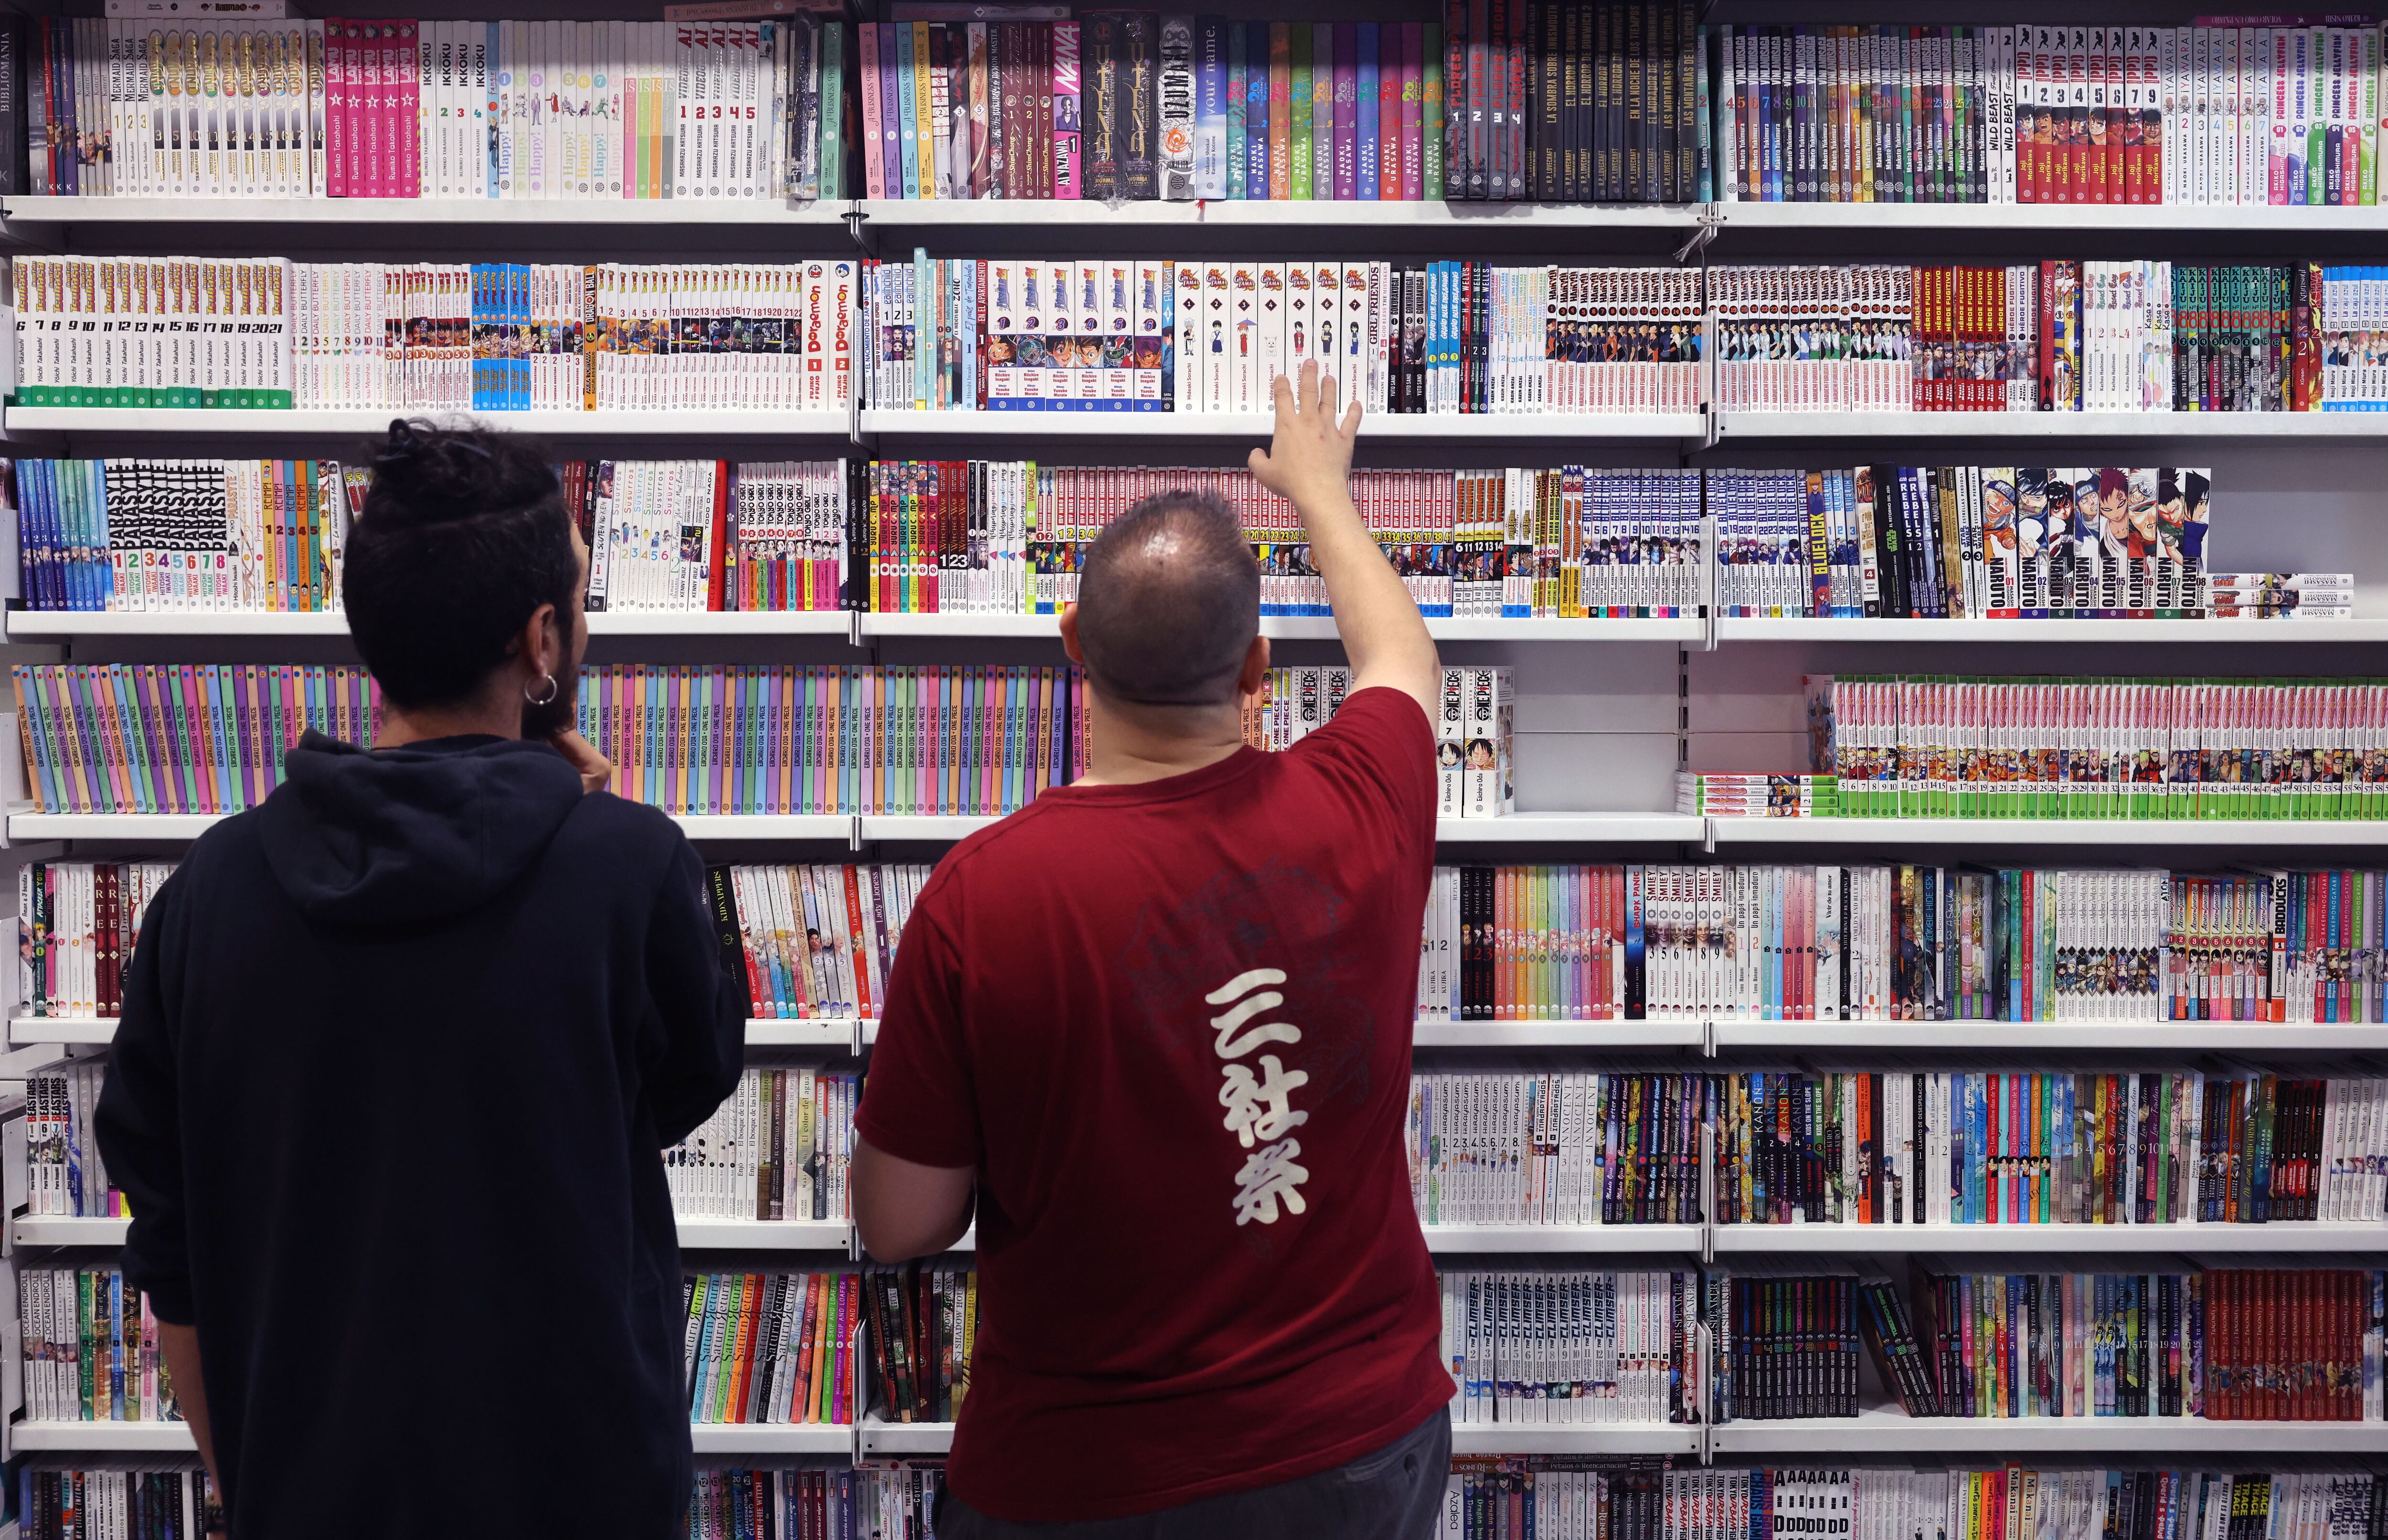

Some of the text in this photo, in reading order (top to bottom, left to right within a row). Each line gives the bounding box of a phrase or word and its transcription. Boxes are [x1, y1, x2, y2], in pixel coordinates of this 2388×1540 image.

[1, 32, 10, 112] BIBLIOMANIA
[111, 38, 121, 102] MERMAID SAGA
[328, 47, 339, 84] LAMU
[1055, 24, 1079, 94] NANA
[1205, 26, 1216, 115] your name.
[746, 107, 755, 119] 5
[1989, 92, 1998, 150] WILD BEAST
[2333, 80, 2341, 118] PRINCESS
[499, 130, 510, 175] Happy!
[1055, 139, 1070, 186] AI YAZAWA
[1071, 138, 1076, 152] 1
[16, 321, 26, 331] 6
[807, 284, 821, 352] Doraemon
[122, 465, 139, 550] PARASYTE
[275, 483, 284, 510] REIMP!
[634, 467, 643, 512] Susurros
[1067, 515, 1075, 523] MY
[129, 554, 139, 568] 2
[1475, 542, 1483, 551] 12
[1813, 513, 1826, 574] BLUELOCK
[1991, 557, 2004, 607] NARUTO
[2005, 577, 2014, 585] 01
[1477, 727, 1482, 735] 8
[108, 874, 117, 929] ARTE
[714, 871, 729, 922] KIDNAPPERS
[1672, 872, 1681, 902] SMILEY
[2274, 878, 2287, 935] BADDUCKS
[853, 916, 858, 925] La
[1751, 903, 1759, 918] papá
[27, 1078, 37, 1122] BEASTARS
[1205, 968, 1309, 1226] 三社祭
[1561, 1084, 1571, 1147] INNOCENT
[1754, 1088, 1763, 1133] KANON
[776, 1322, 790, 1362] Saturn
[1449, 1490, 1458, 1530] Azalea
[2010, 1471, 2018, 1513] Makanai
